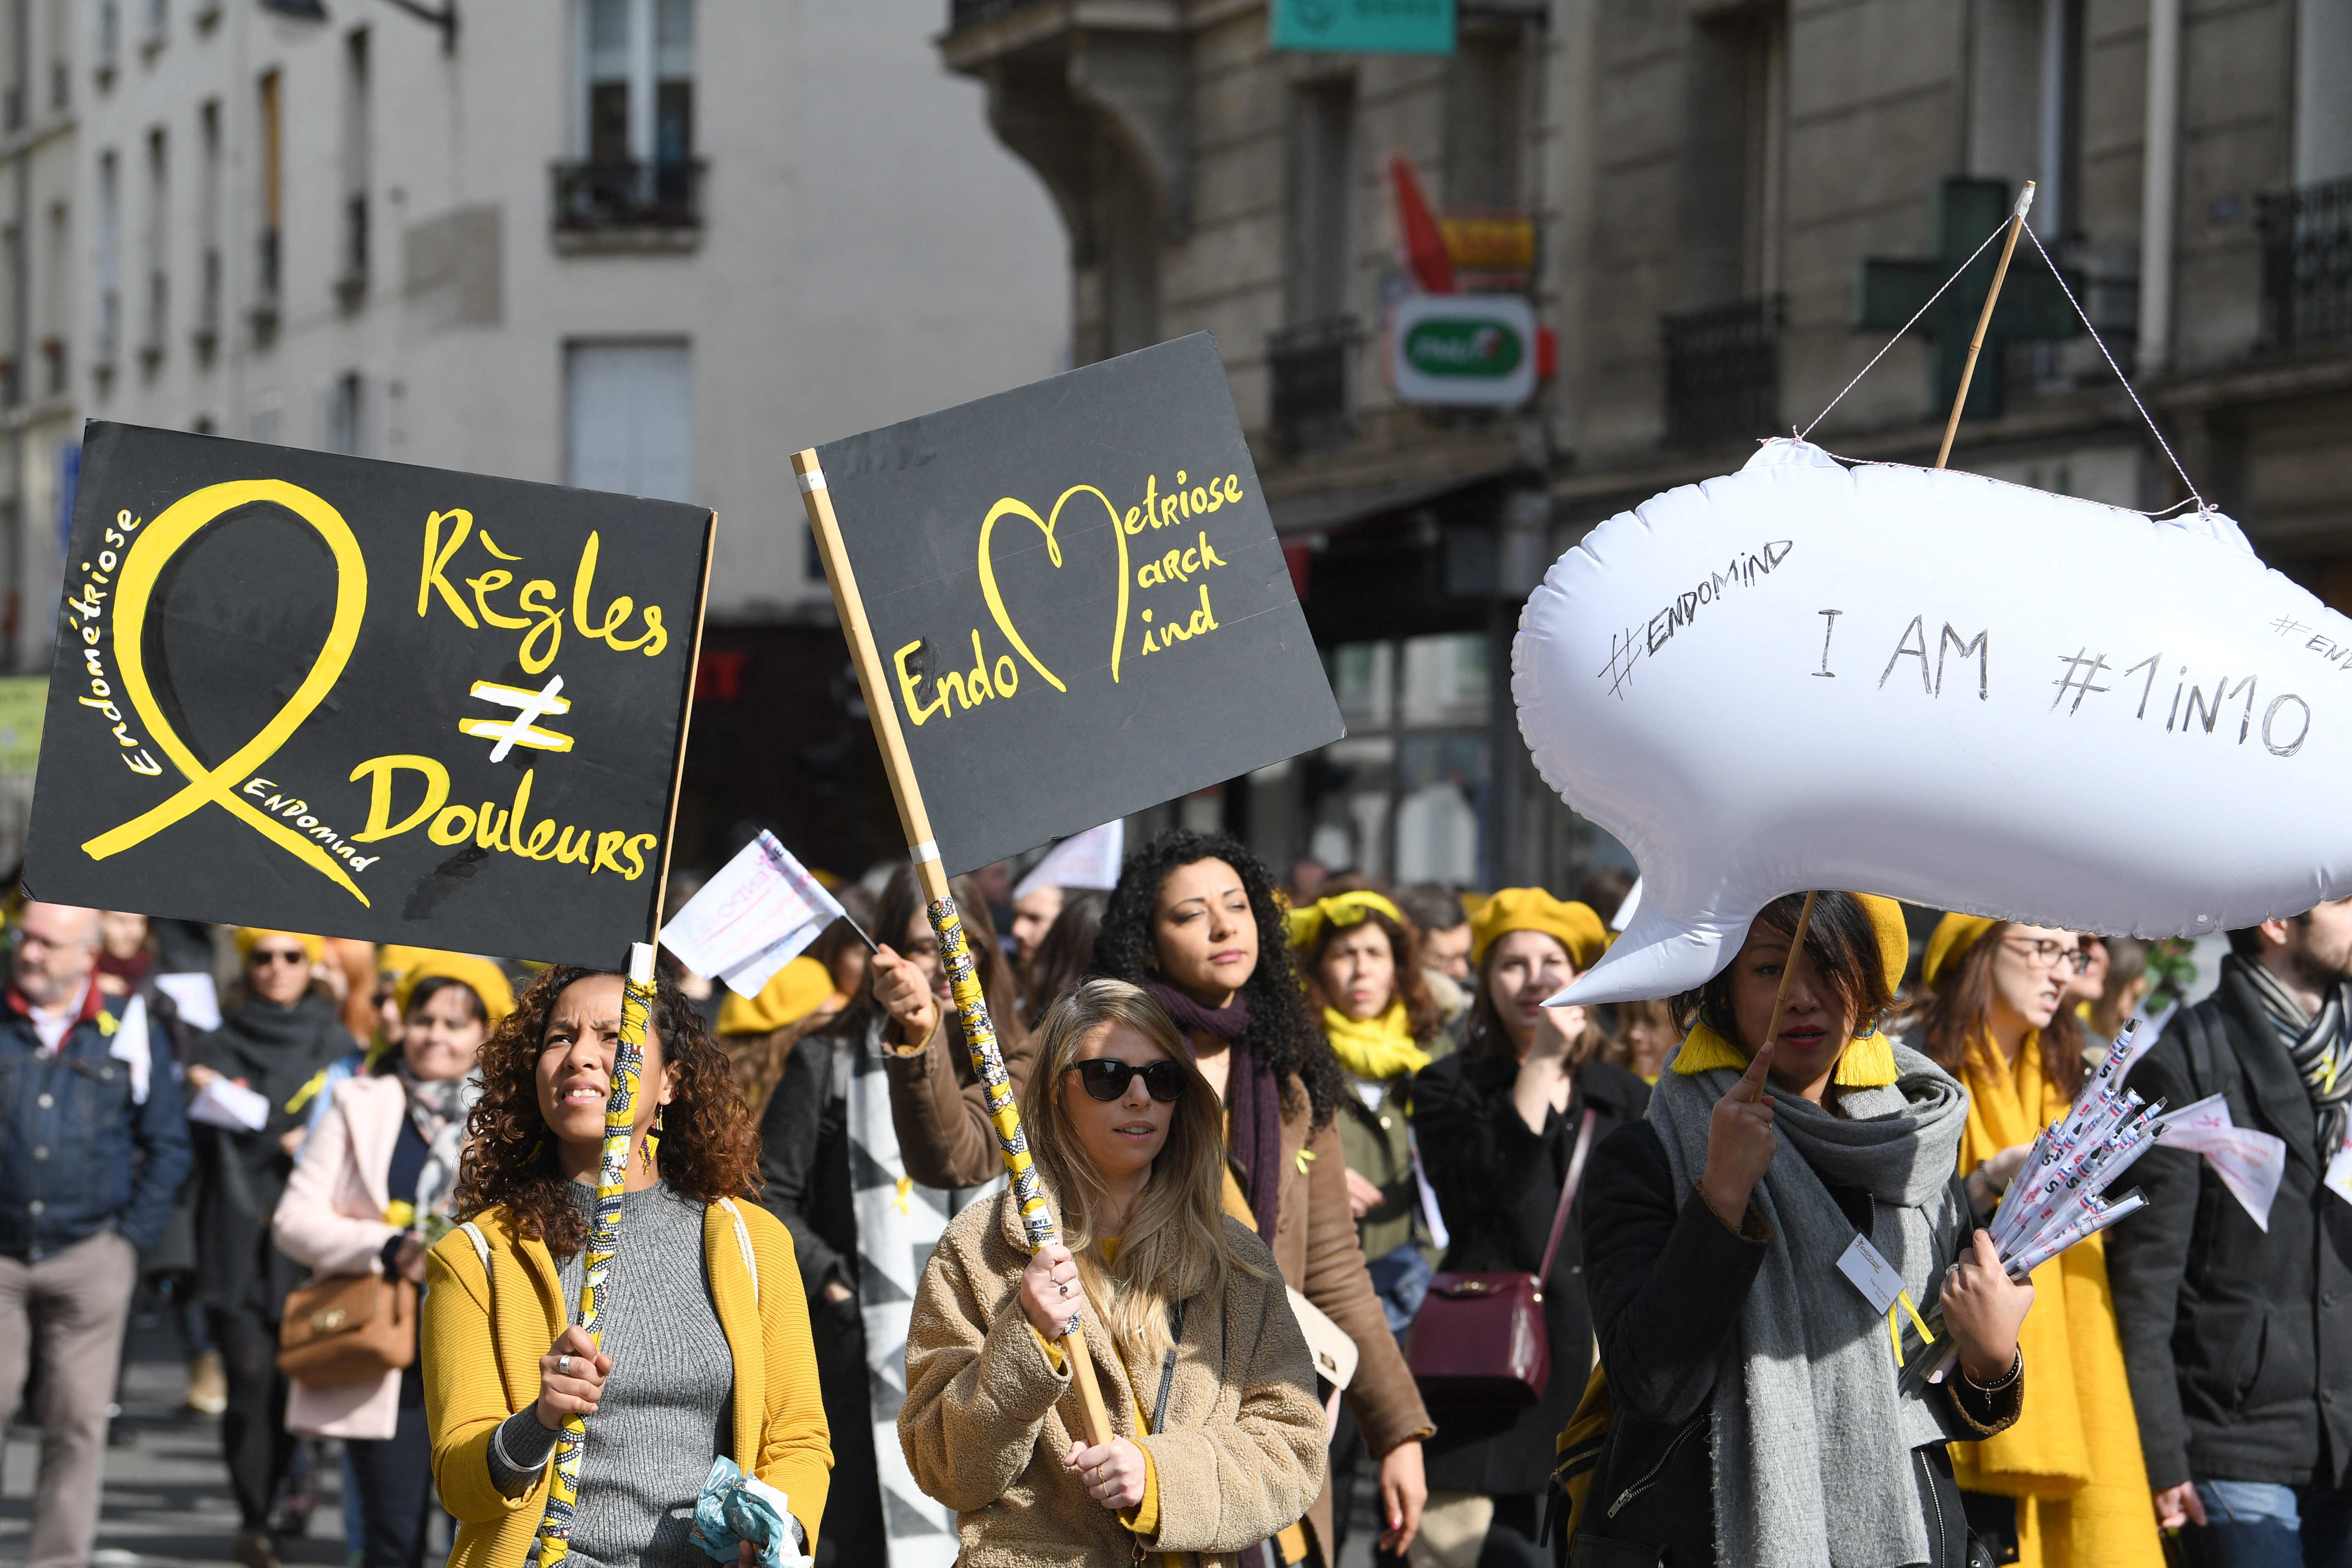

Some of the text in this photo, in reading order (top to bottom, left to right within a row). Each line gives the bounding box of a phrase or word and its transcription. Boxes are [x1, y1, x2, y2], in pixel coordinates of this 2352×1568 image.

[418, 509, 667, 674] Règles
[1138, 531, 1227, 588] arch
[1142, 584, 1219, 656] ind
[1811, 609, 1843, 678] I
[1878, 614, 1989, 701] AM
[349, 754, 657, 880] Douleurs
